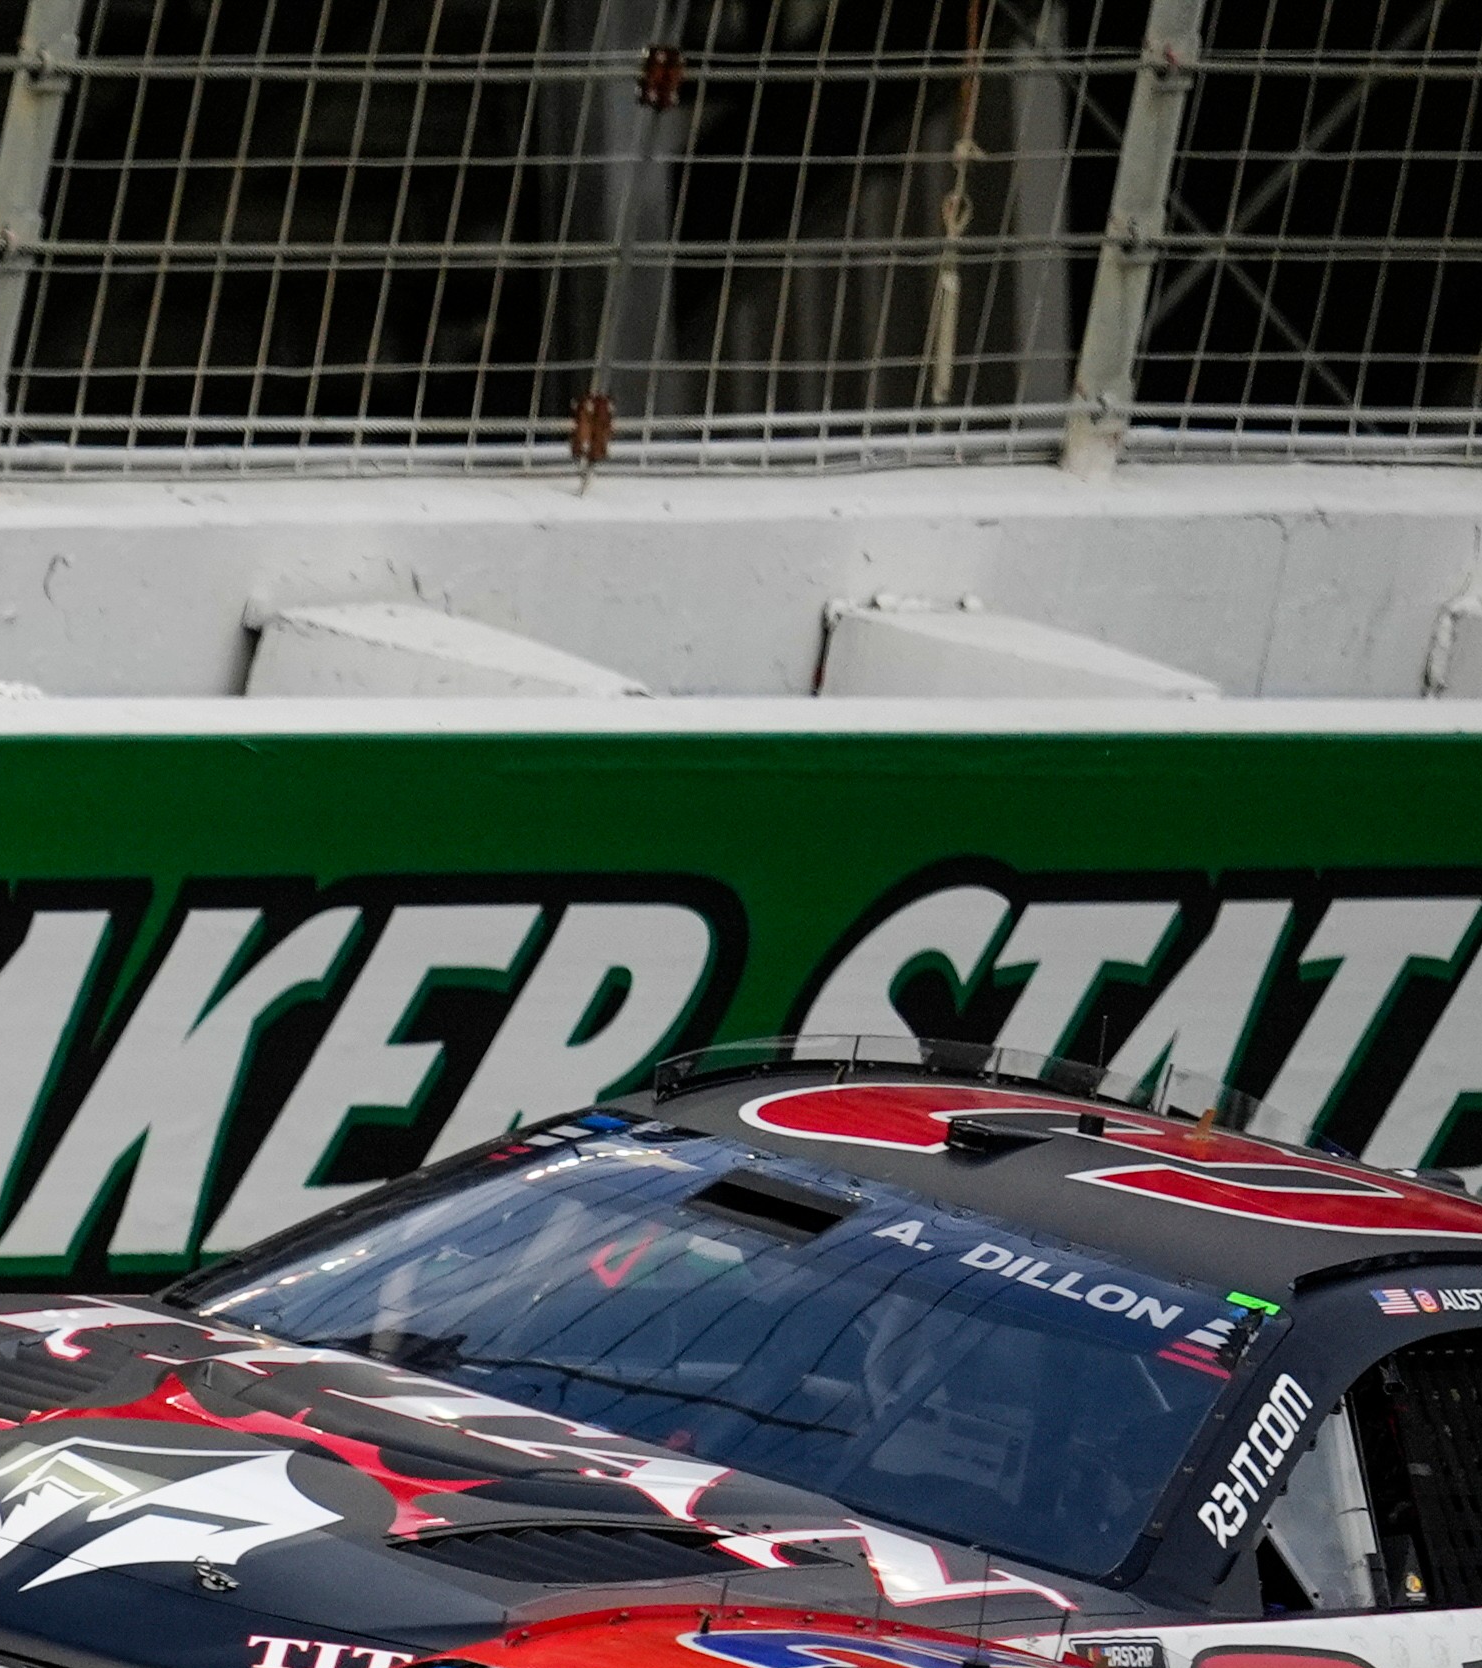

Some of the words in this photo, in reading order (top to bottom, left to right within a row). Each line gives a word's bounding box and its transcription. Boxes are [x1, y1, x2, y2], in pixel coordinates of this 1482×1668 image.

[790, 884, 1482, 1185] STAT
[872, 1219, 936, 1252] A.
[958, 1242, 1184, 1330] DILLON
[1196, 1372, 1315, 1550] R3-IT.COM
